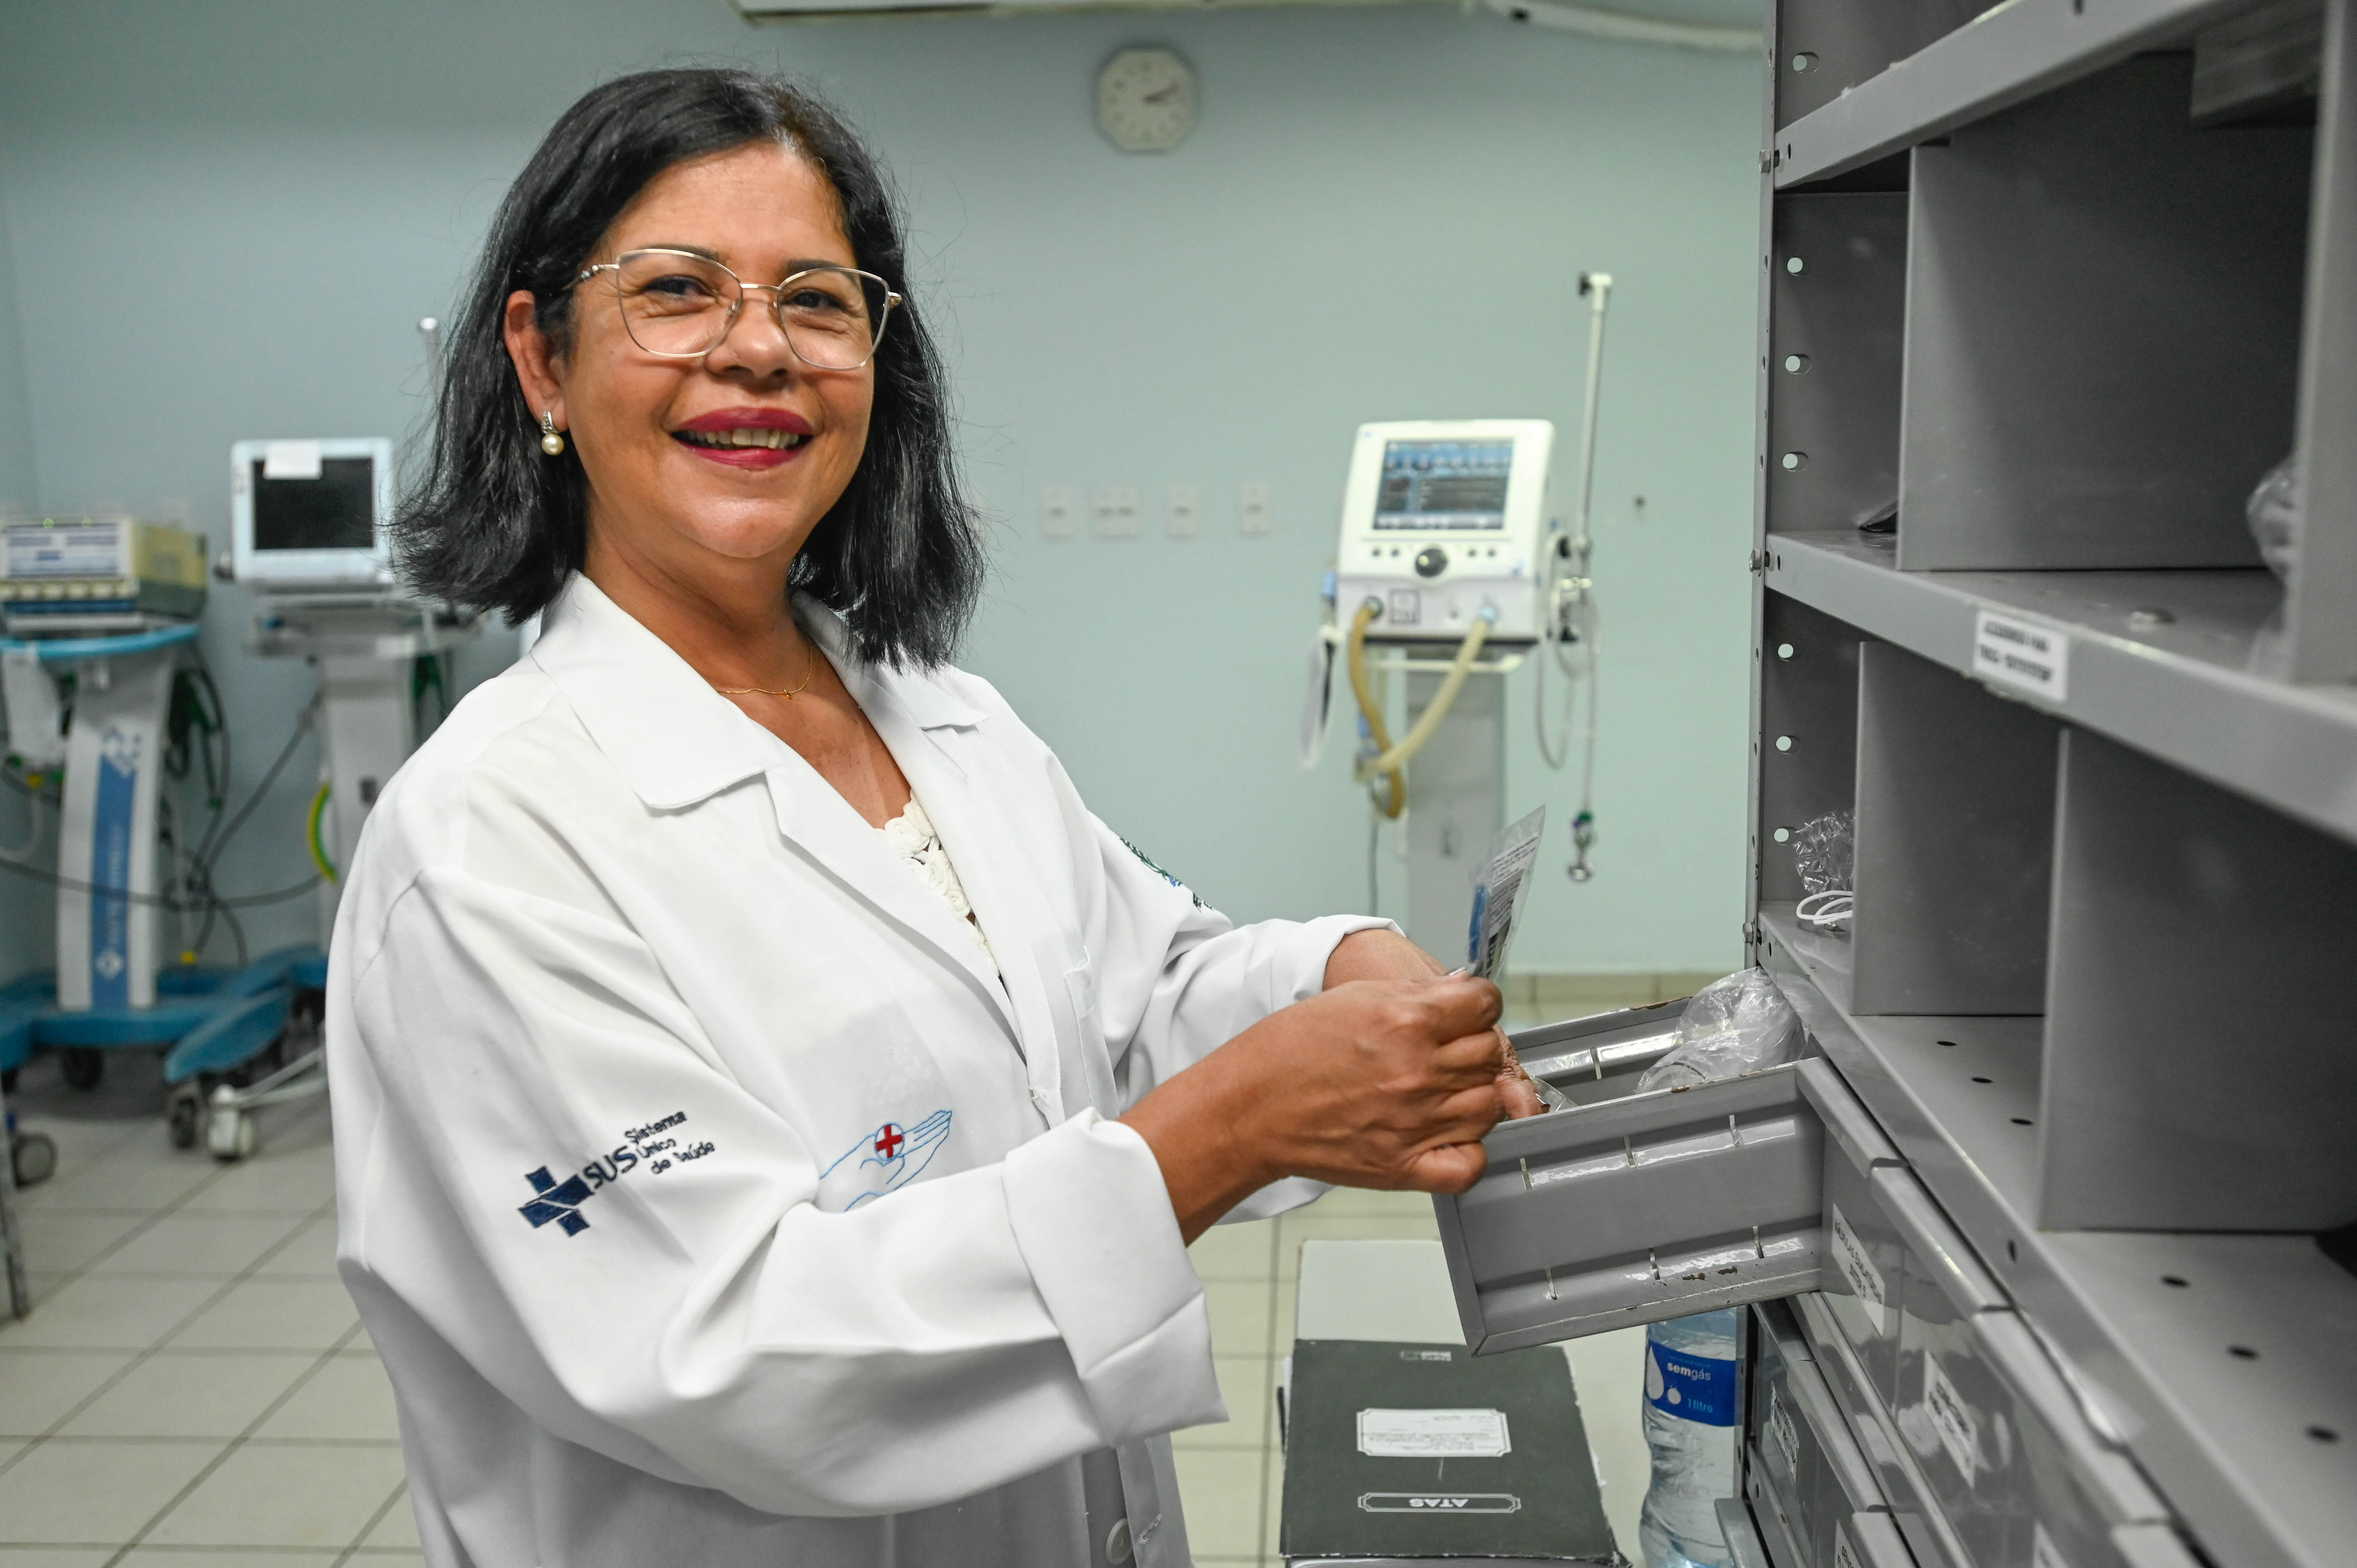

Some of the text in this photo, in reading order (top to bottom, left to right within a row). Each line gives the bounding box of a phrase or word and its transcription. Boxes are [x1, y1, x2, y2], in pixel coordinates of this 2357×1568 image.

[624, 1111, 687, 1144] Sistema
[583, 1145, 638, 1189] SUS
[651, 1142, 715, 1174] de Saúde
[1688, 1397, 1713, 1413] 1 litro
[1408, 1498, 1468, 1508] ATAS
